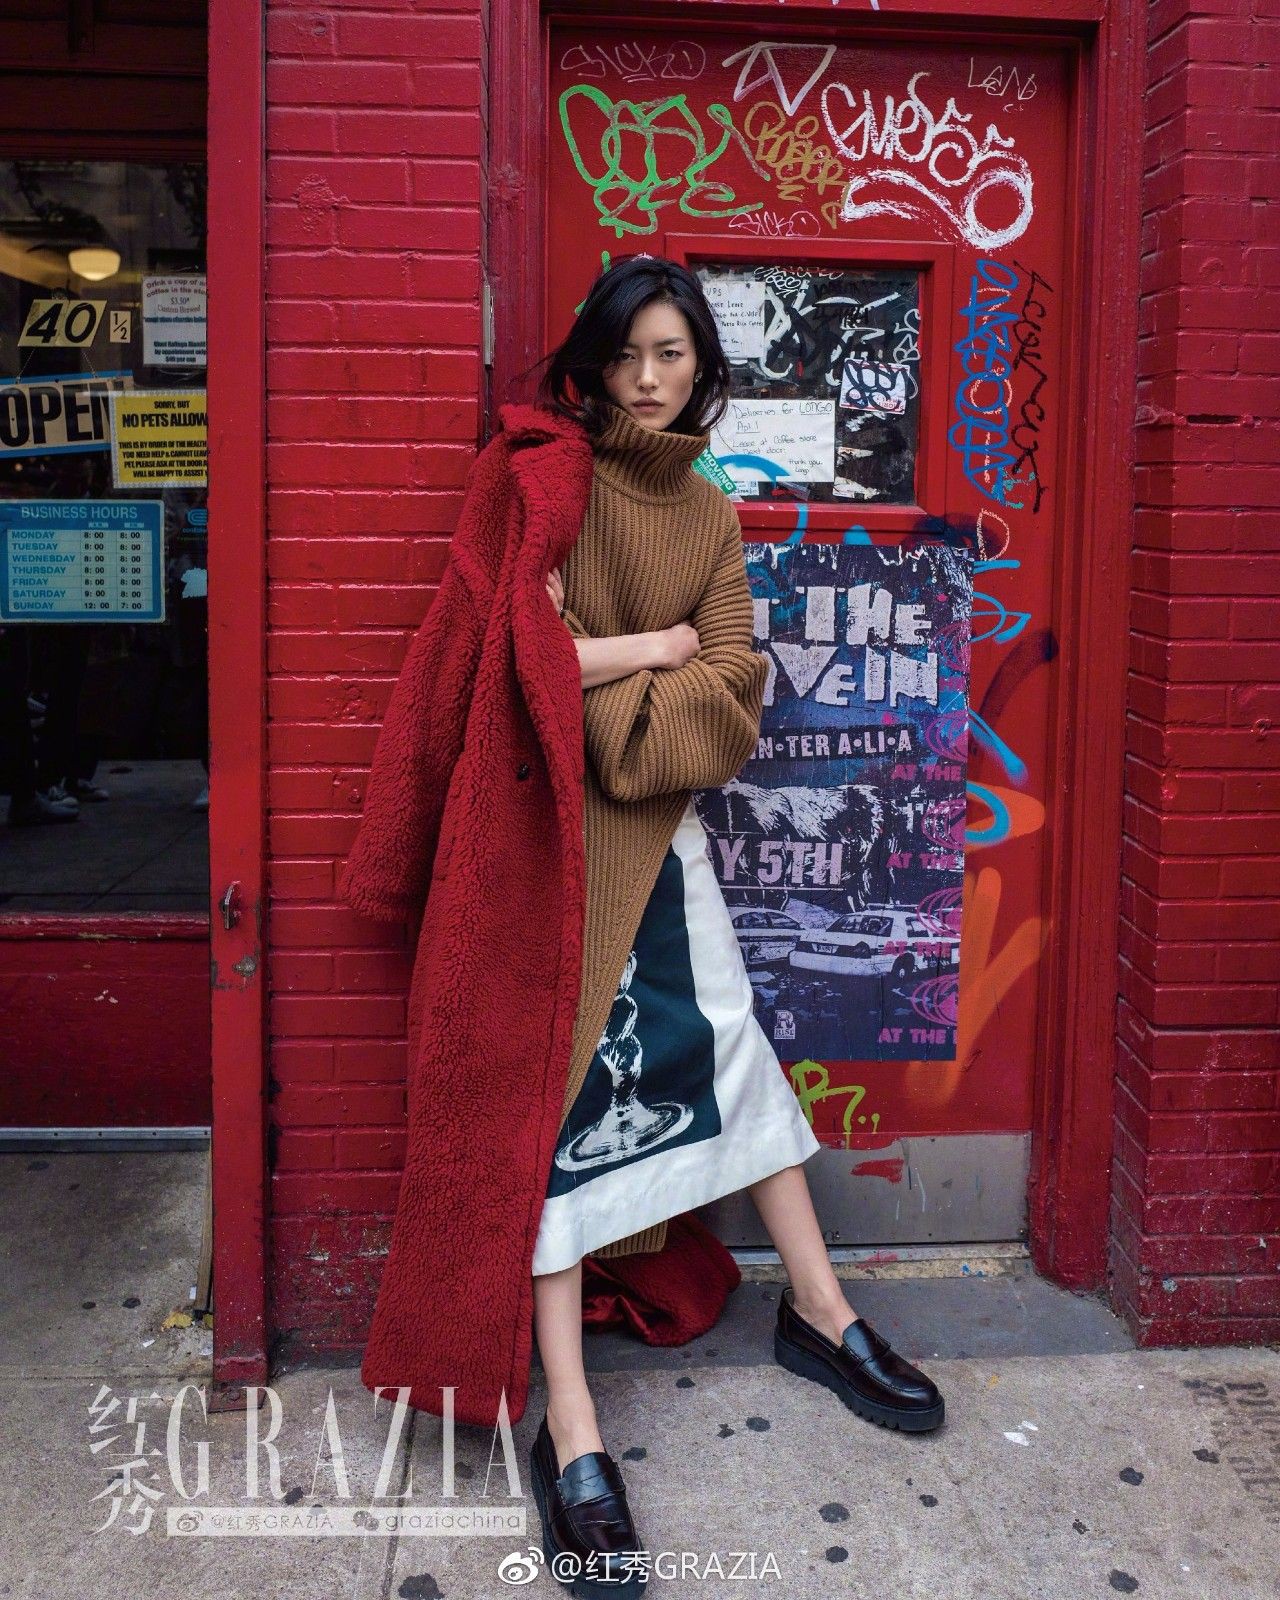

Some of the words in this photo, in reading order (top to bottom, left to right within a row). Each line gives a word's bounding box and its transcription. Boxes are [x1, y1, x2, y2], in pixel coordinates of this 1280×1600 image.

[26, 302, 97, 344] 40
[782, 402, 793, 415] for
[122, 413, 139, 428] NO
[140, 413, 169, 428] PETS
[21, 506, 87, 518] BUSINESS
[91, 506, 138, 518] HOURS
[12, 531, 55, 539] MONDAY
[12, 566, 66, 574] THURSDAY
[12, 578, 48, 586] FRIDAY
[13, 590, 66, 598] SATURDAY
[796, 583, 932, 646] THE
[891, 764, 917, 781] AT
[922, 764, 963, 782] THE
[757, 840, 844, 885] 5TH
[885, 852, 912, 869] AT
[919, 852, 957, 869] THE
[883, 940, 908, 956] AT
[916, 941, 952, 958] THE
[878, 1028, 903, 1044] AT
[912, 1028, 946, 1044] THE
